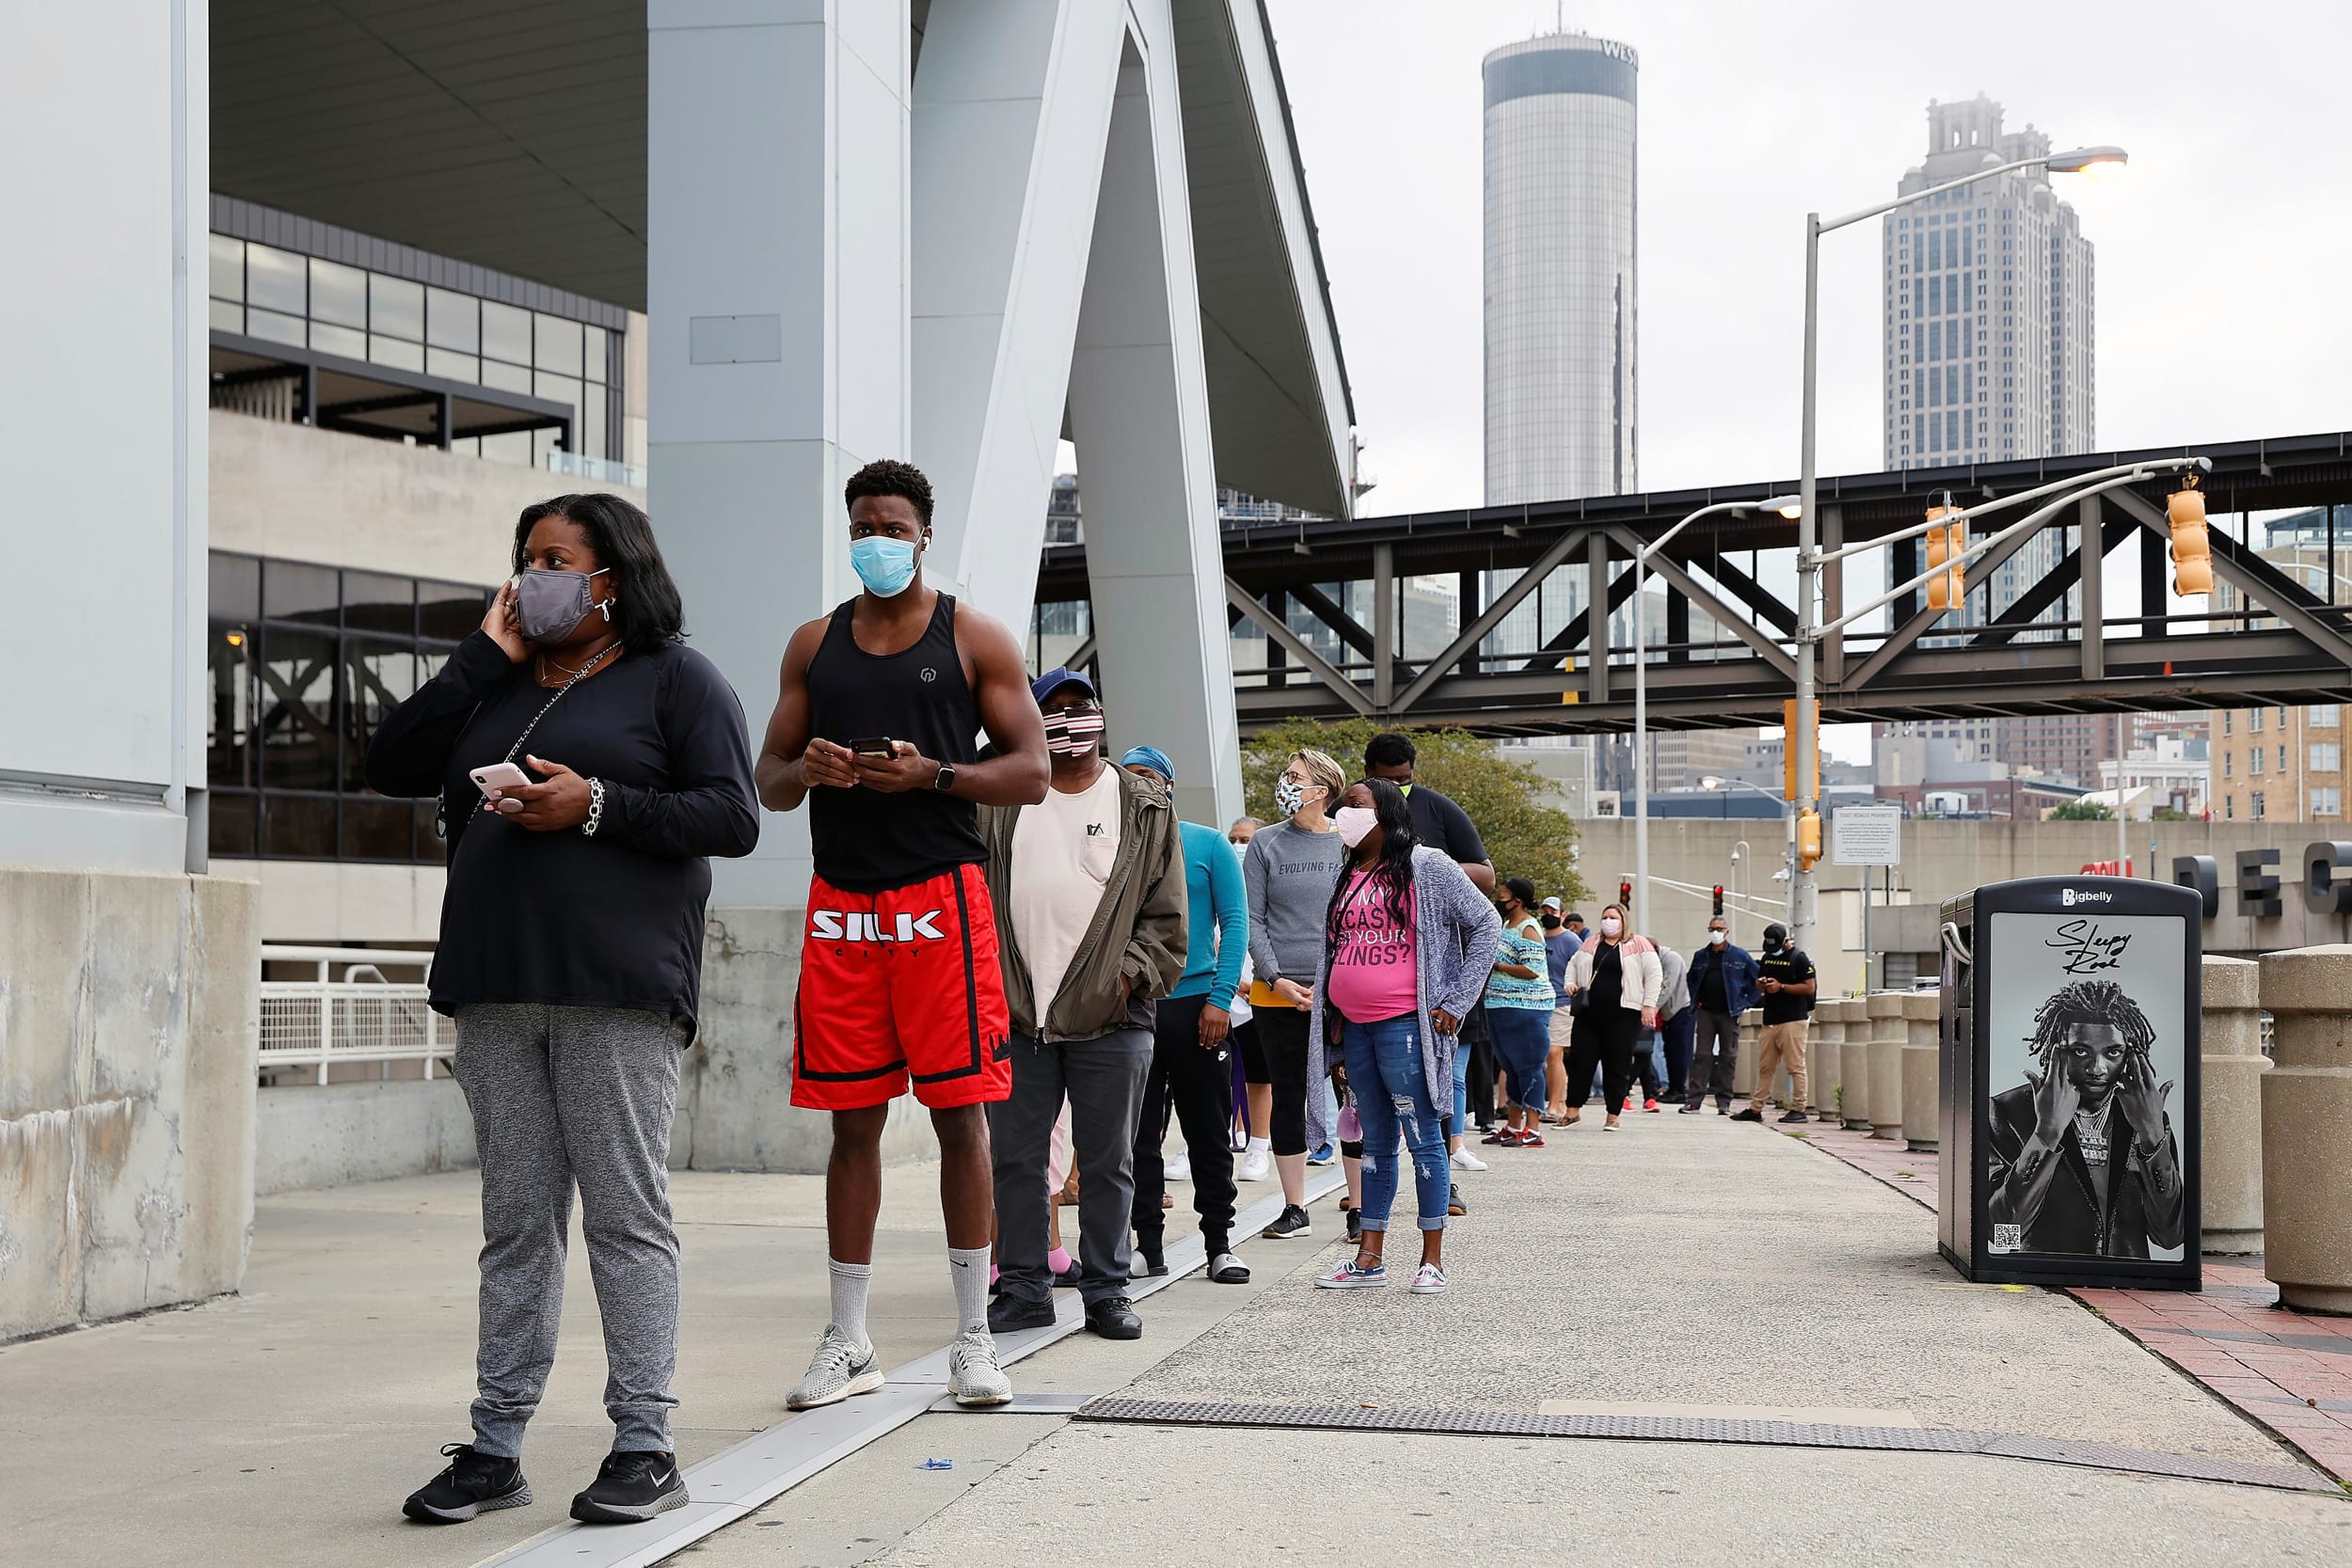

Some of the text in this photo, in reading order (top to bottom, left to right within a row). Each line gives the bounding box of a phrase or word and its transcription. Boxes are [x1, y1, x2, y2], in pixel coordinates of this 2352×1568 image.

[1600, 39, 1638, 68] WES
[1279, 861, 1325, 875] EVOLVING
[2062, 888, 2113, 906] Bigbelly
[810, 909, 946, 942] SILK
[1355, 929, 1406, 944] YOUR
[835, 948, 919, 958] CITY
[1335, 943, 1411, 966] LINGS?
